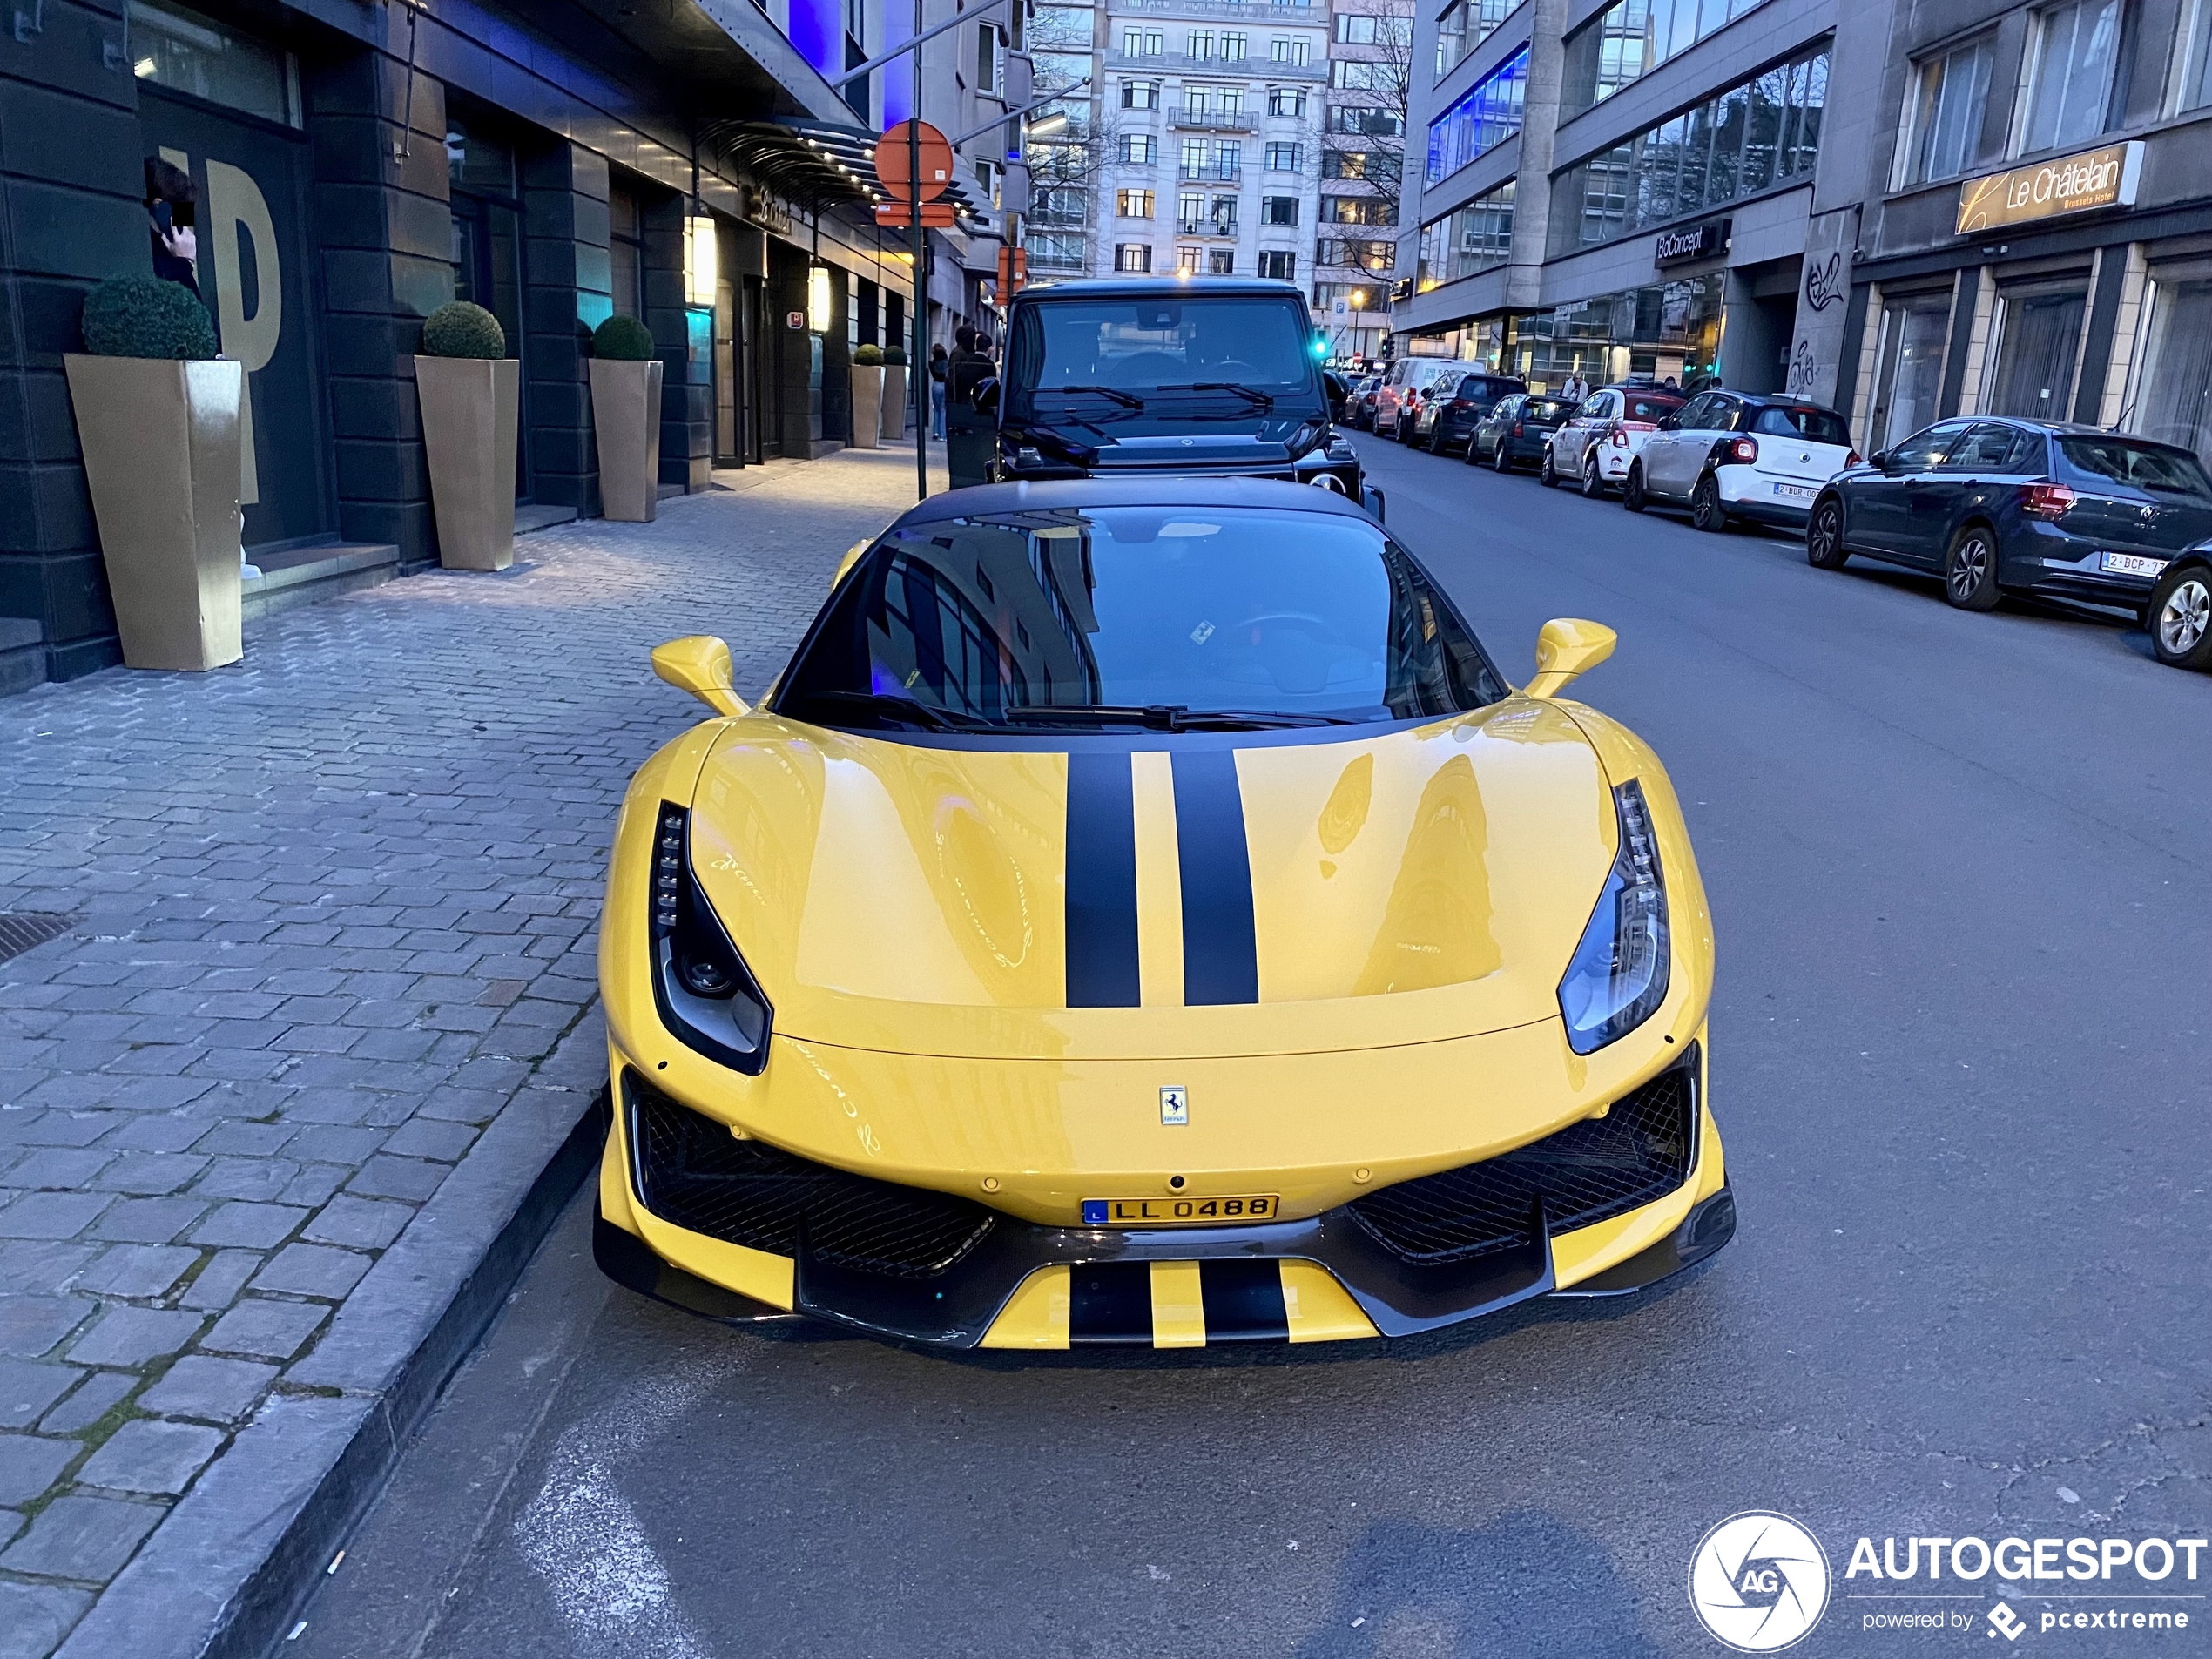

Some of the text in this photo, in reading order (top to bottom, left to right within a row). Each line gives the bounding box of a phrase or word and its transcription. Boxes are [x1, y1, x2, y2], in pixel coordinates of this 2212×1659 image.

[2007, 154, 2119, 209] Le Châtelain
[2065, 191, 2114, 209] Brussels Hotel
[1657, 226, 1703, 259] BoConcept
[1116, 1203, 1160, 1218] LL
[1174, 1199, 1269, 1217] 0488
